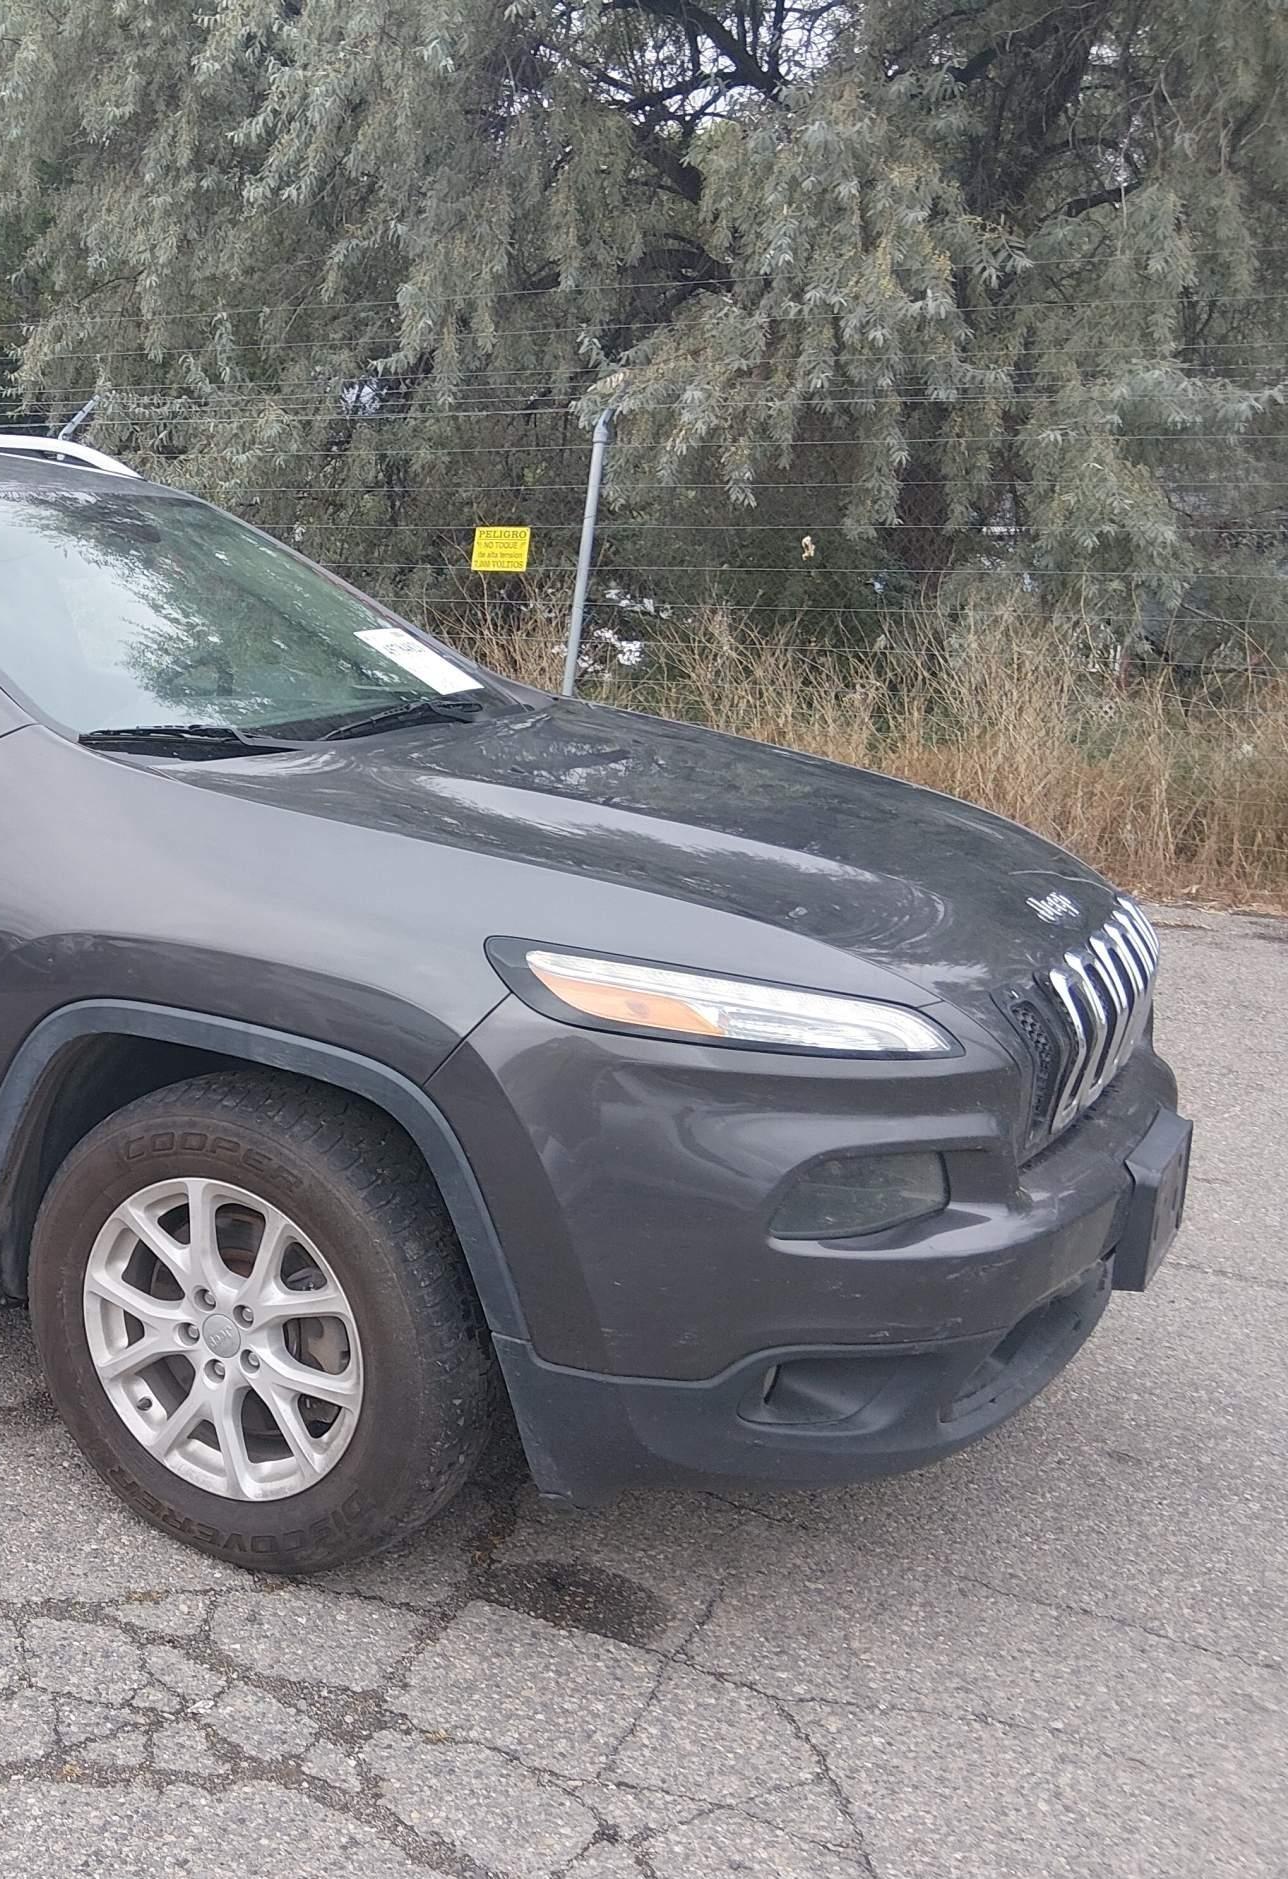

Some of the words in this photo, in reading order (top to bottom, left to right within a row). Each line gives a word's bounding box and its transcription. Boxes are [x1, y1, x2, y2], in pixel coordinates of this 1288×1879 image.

[478, 530, 527, 539] PELIGRO
[1025, 891, 1080, 924] Jeep
[125, 1131, 305, 1199] COOPER
